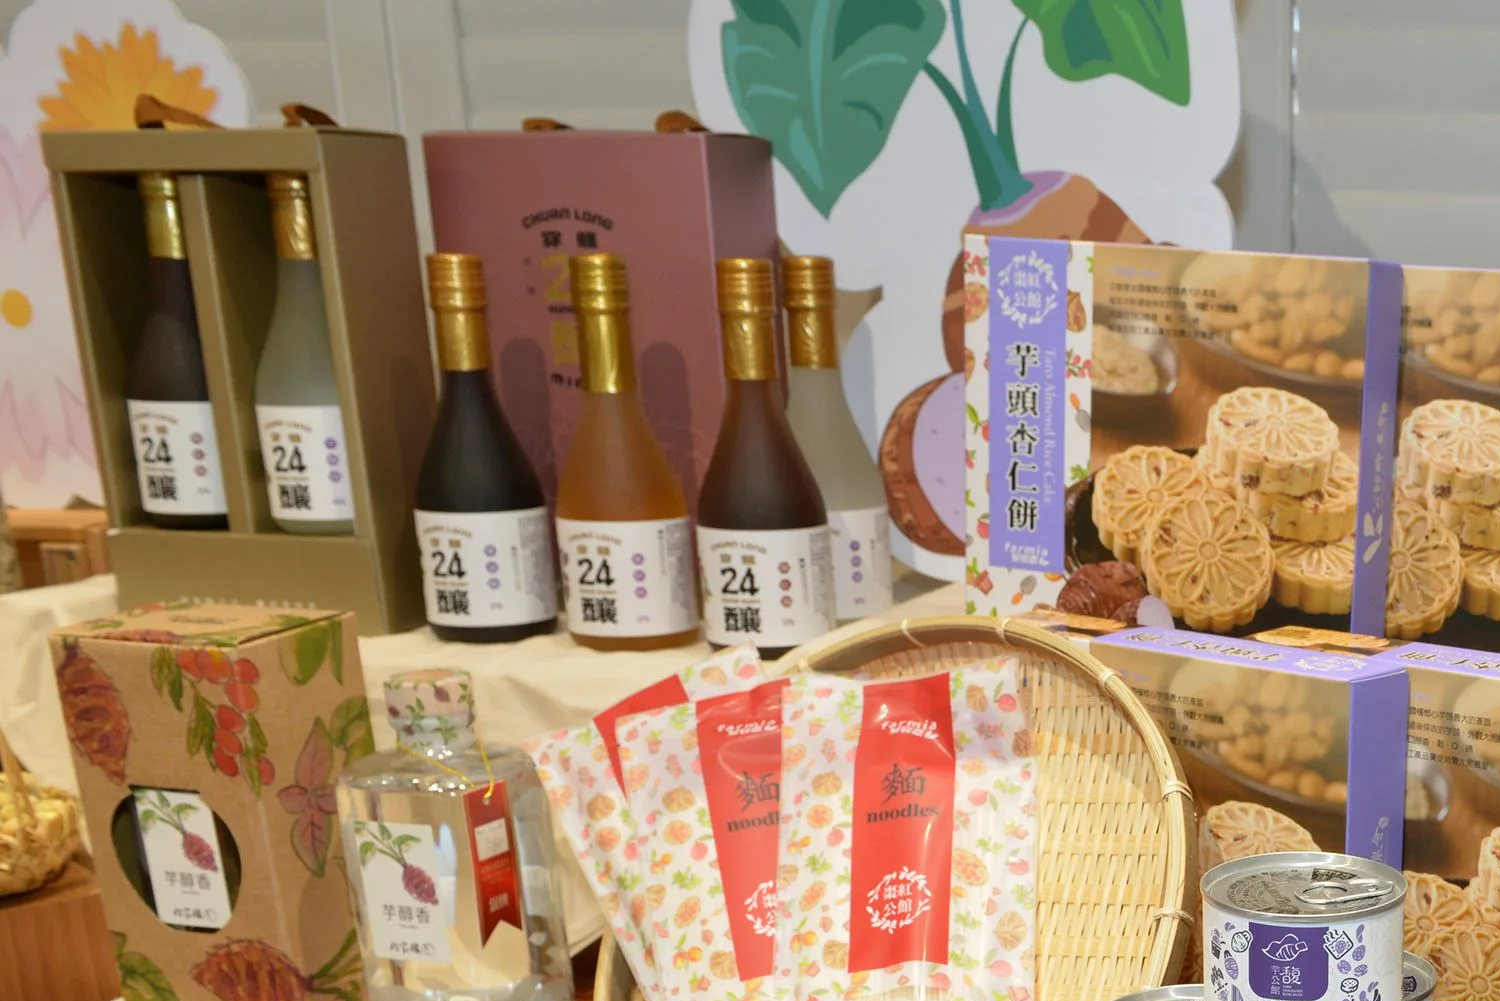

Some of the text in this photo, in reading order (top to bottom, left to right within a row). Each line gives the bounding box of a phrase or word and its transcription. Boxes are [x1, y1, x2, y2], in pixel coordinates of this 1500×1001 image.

[574, 208, 613, 231] LONG
[141, 438, 174, 464] 24
[1006, 344, 1040, 531] 芋頭杏仁餅
[273, 446, 306, 473] 24
[432, 551, 466, 579] 24
[577, 559, 615, 587] 24
[721, 567, 759, 596] 24
[735, 771, 780, 812] 麵
[881, 763, 925, 804] 麵
[866, 803, 940, 824] noodles
[1280, 966, 1302, 985] 馥
